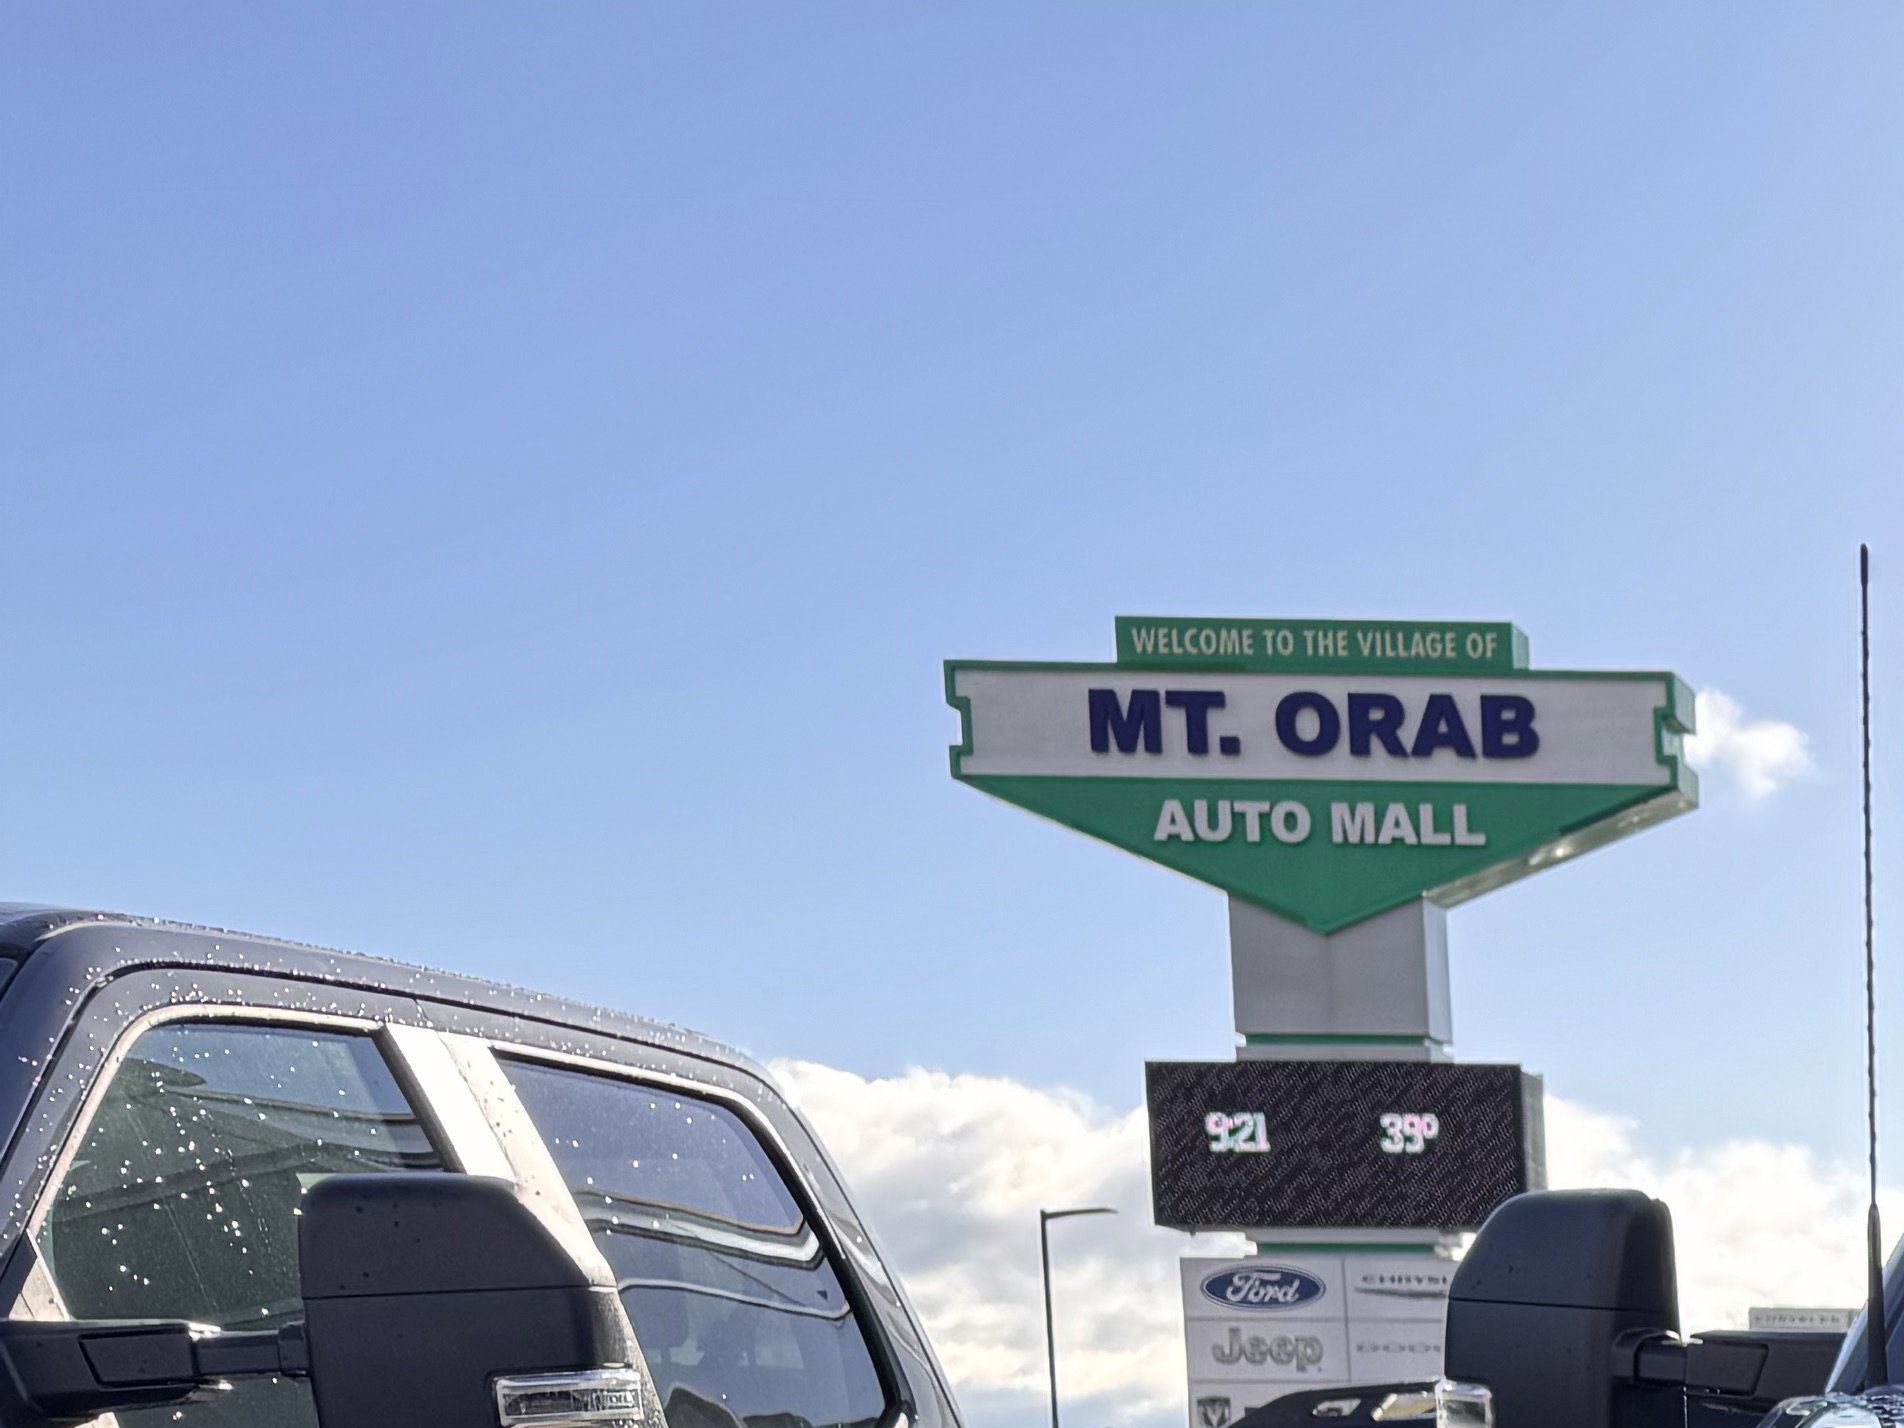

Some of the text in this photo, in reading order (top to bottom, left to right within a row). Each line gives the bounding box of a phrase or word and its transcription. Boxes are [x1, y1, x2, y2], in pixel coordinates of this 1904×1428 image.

[1131, 627, 1498, 659] WELCOME TO THE VILLAGE OF
[1087, 688, 1541, 760] MT. ORAB
[1153, 799, 1487, 846] AUTO MALL
[1225, 1271, 1300, 1304] Ford
[1211, 1326, 1324, 1373] Jeep
